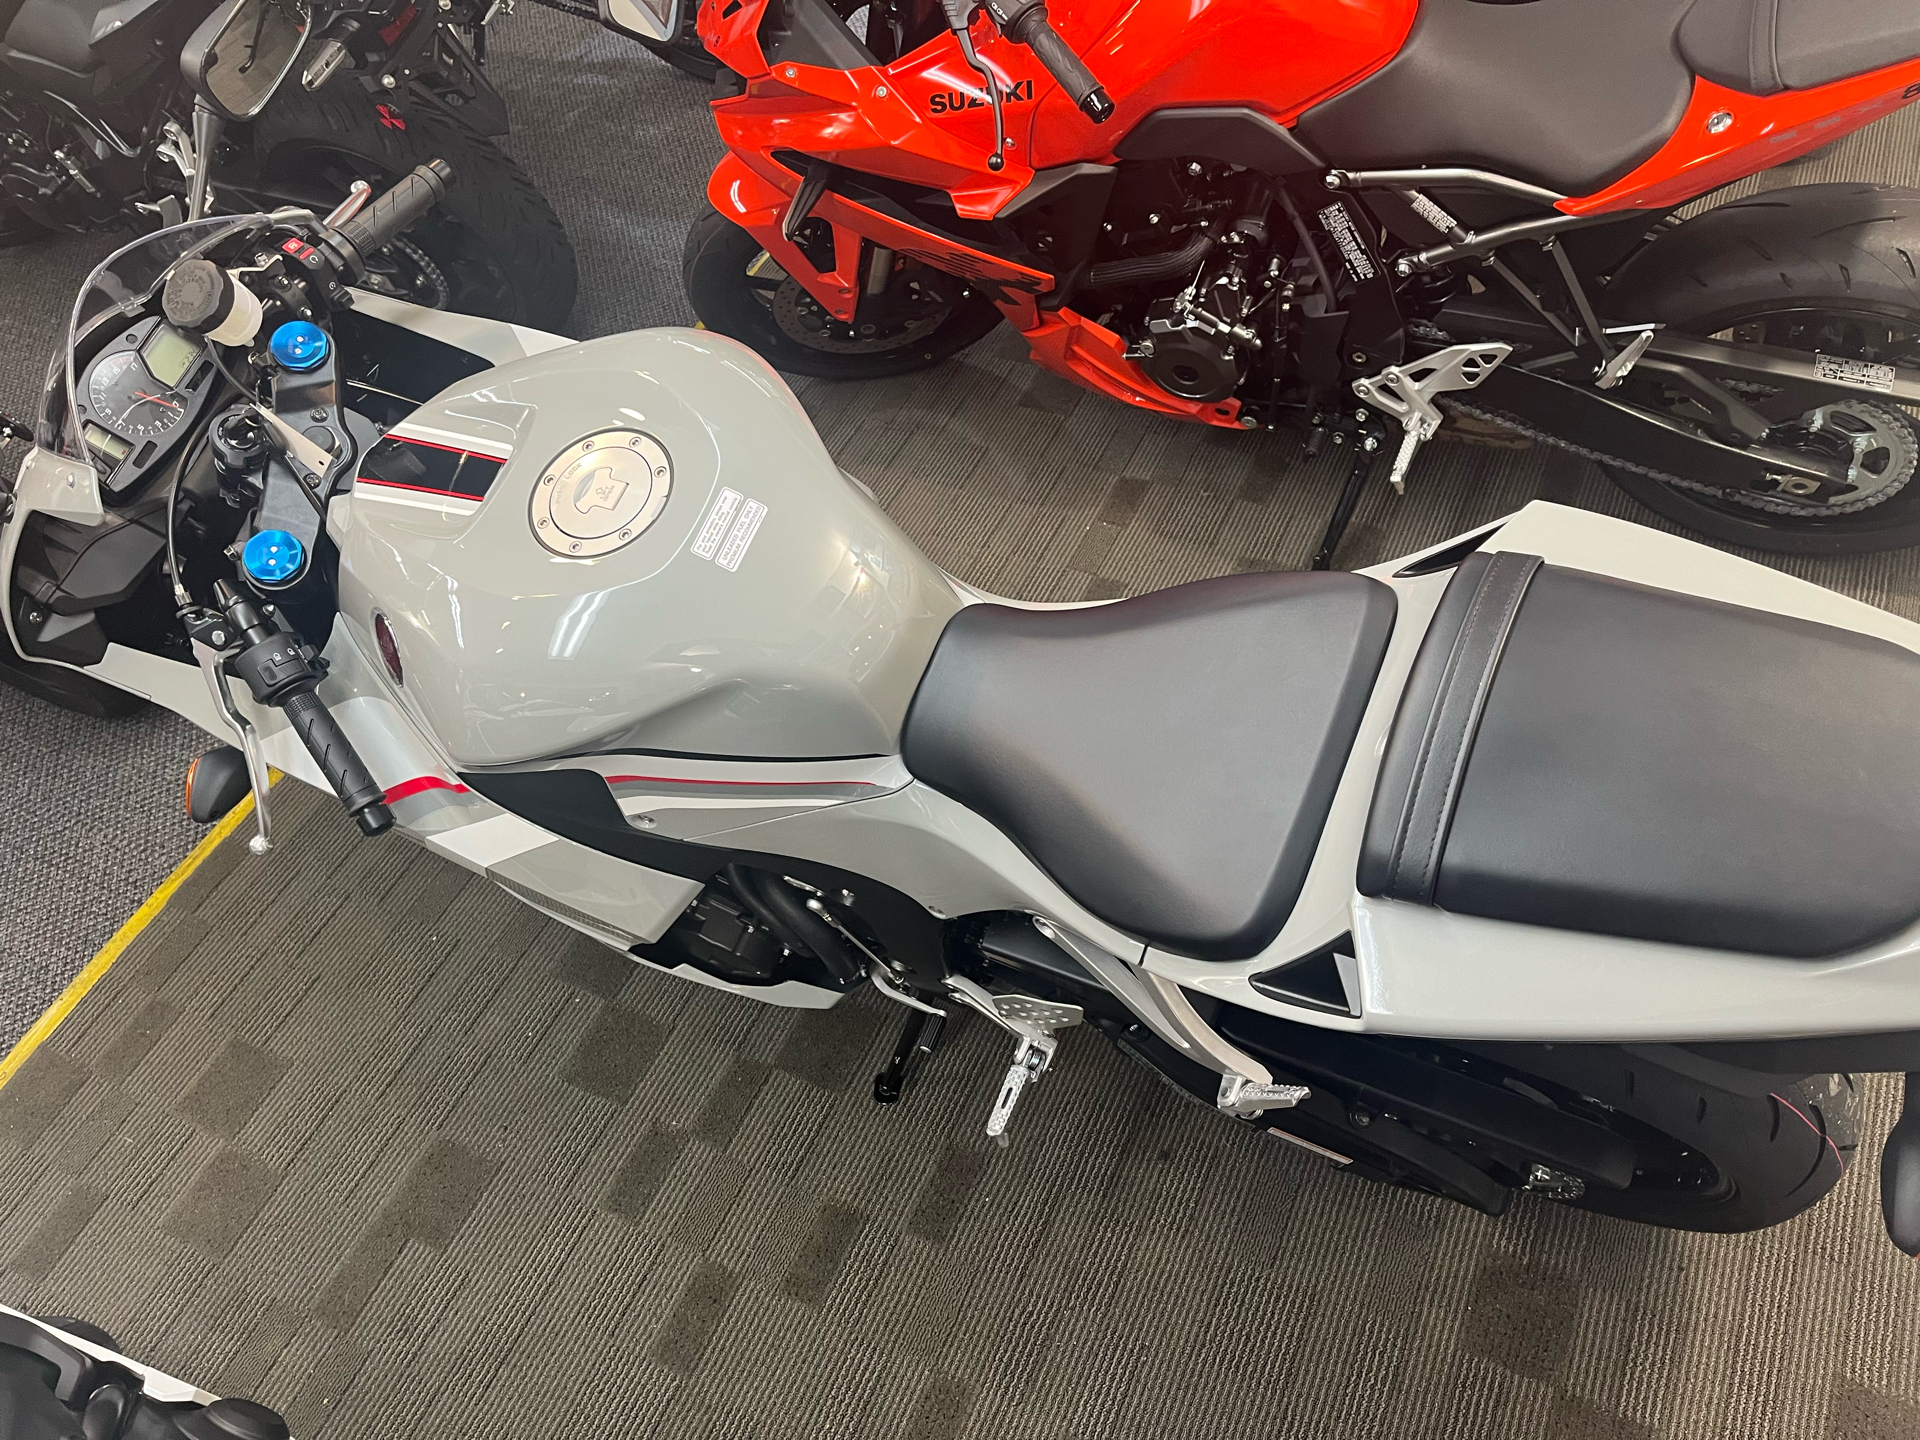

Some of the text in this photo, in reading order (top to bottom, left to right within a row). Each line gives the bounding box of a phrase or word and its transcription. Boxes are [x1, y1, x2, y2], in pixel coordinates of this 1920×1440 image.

[722, 506, 754, 560] UNLEADED FUEL ONLY
[727, 506, 762, 566] PREMIUM RECOMMENDED
